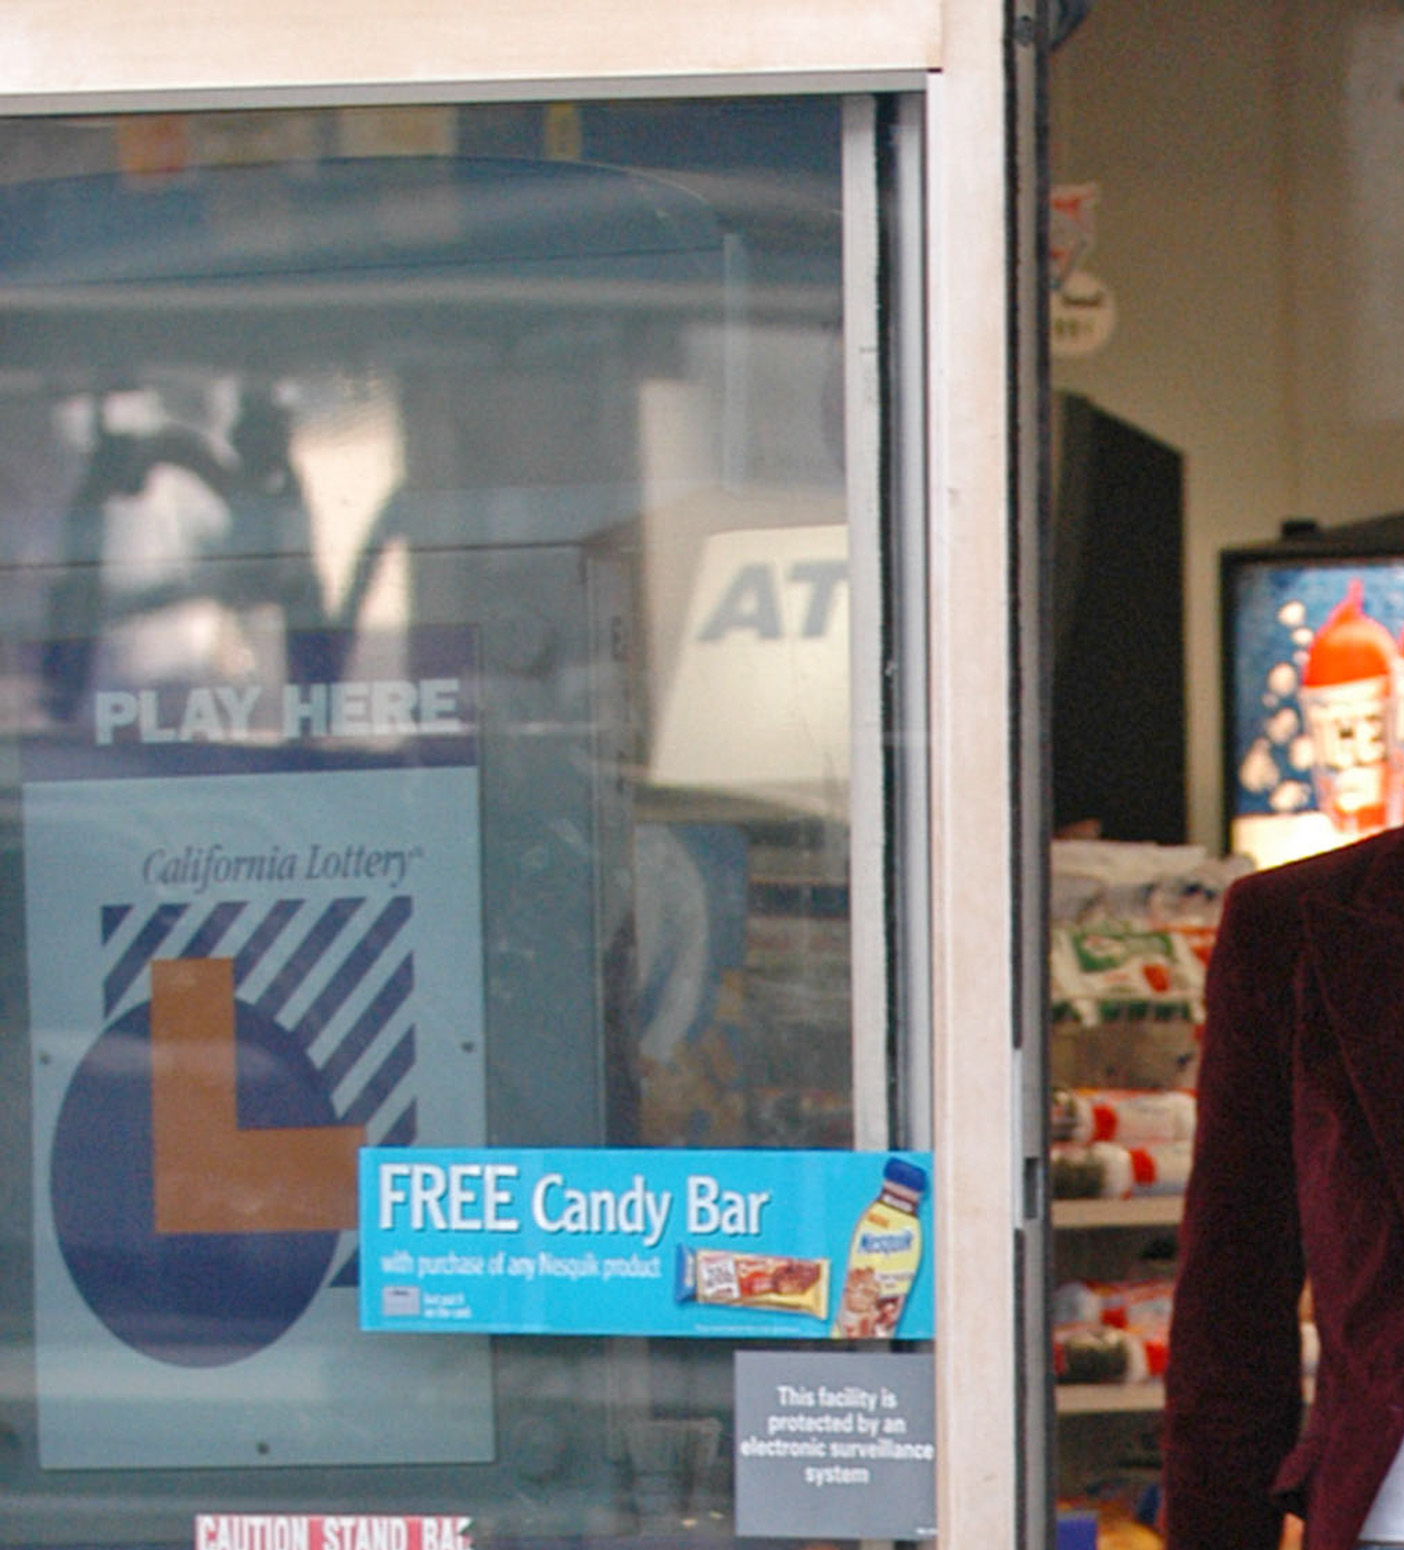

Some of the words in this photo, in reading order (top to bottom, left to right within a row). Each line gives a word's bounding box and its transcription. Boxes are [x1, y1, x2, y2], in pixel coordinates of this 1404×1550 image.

[698, 559, 848, 642] AT
[95, 685, 262, 745] PLAY
[283, 677, 461, 739] HERE
[142, 845, 299, 895] California
[378, 1162, 520, 1232] FREE
[531, 1172, 672, 1248] Candy
[687, 1175, 772, 1236] Bar
[380, 1250, 414, 1274] with
[417, 1252, 484, 1278] purchase
[488, 1252, 505, 1275] of
[507, 1257, 537, 1280] any
[538, 1251, 599, 1280] Nesquik
[602, 1254, 663, 1280] product
[776, 1386, 816, 1407] This
[818, 1386, 878, 1412] facility
[881, 1387, 898, 1409] is
[768, 1413, 854, 1435] protected
[857, 1413, 880, 1438] by
[883, 1418, 906, 1434] an
[740, 1436, 826, 1457] electronic
[829, 1437, 935, 1461] surveillance
[804, 1465, 871, 1487] system
